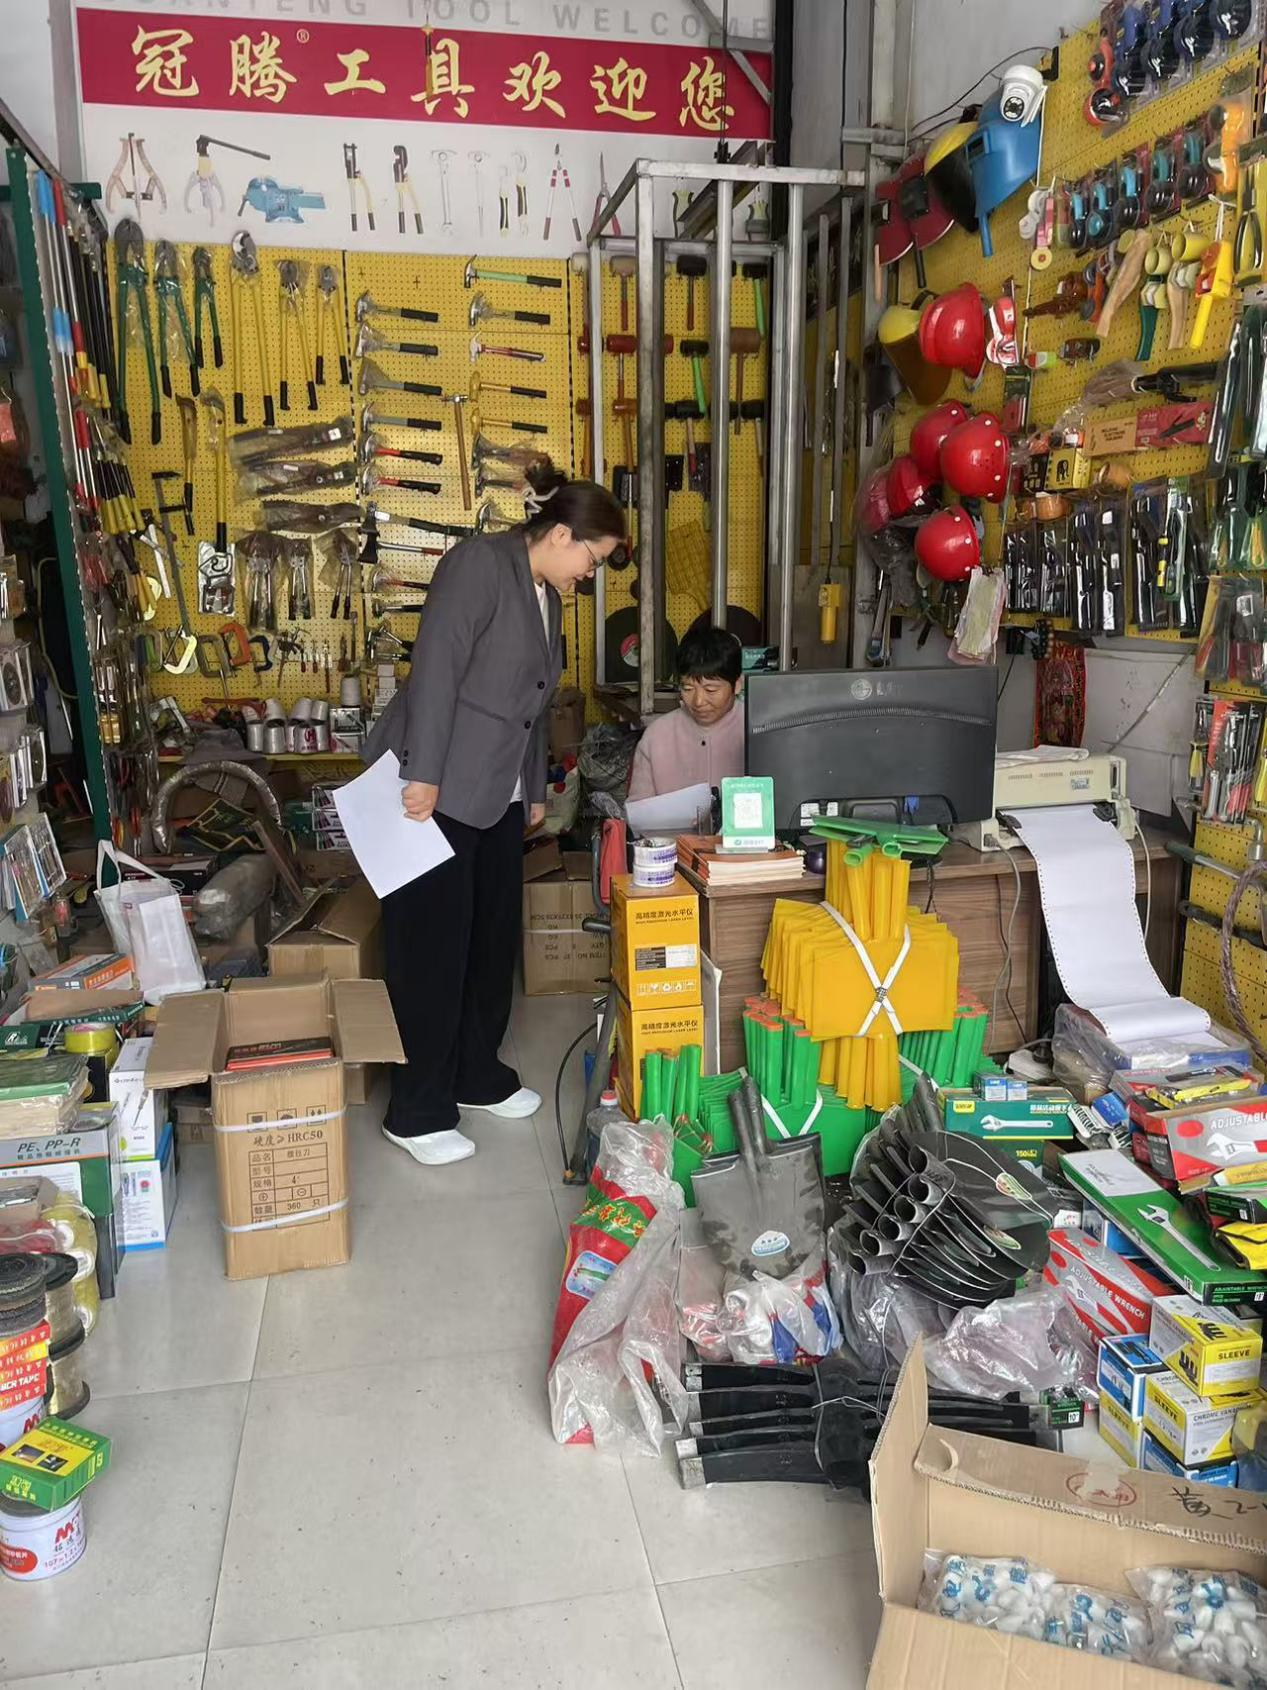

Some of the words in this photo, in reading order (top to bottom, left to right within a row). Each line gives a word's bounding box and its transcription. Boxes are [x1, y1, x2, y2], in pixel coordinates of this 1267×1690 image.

[1114, 1292, 1146, 1320] WRENCH
[1218, 1348, 1250, 1361] SLEEVE
[1154, 1394, 1178, 1422] SLEEVE
[1193, 1411, 1219, 1422] CHROME
